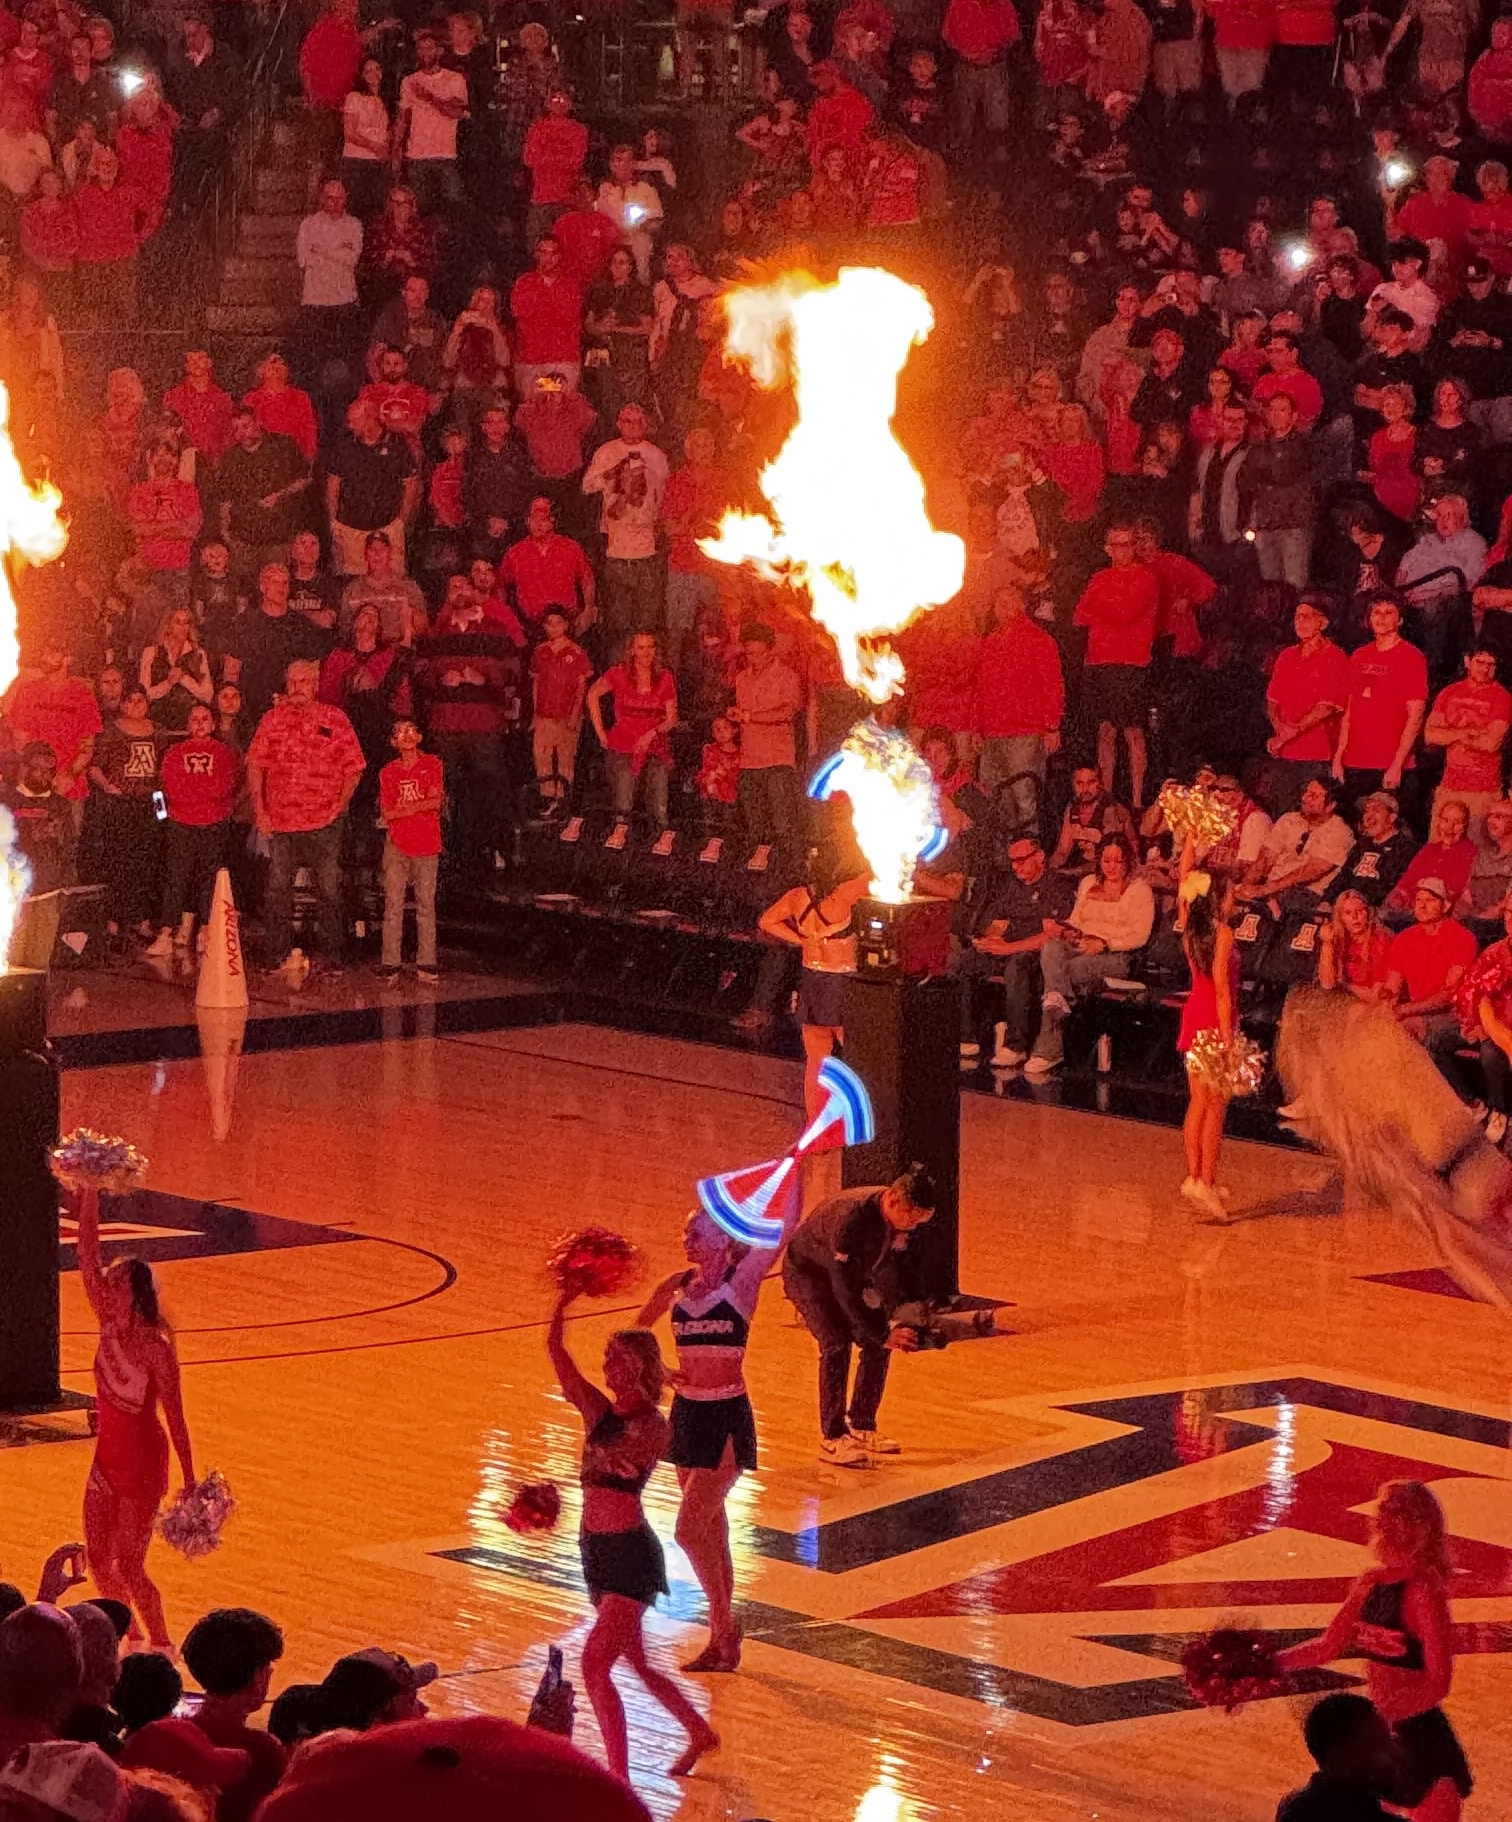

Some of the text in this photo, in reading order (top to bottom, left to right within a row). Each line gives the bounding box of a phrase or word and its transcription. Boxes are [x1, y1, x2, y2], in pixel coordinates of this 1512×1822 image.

[124, 741, 157, 777] A
[1352, 851, 1380, 880] A
[223, 900, 241, 976] ARIZONA
[1234, 914, 1261, 942] A
[1290, 923, 1318, 952] A
